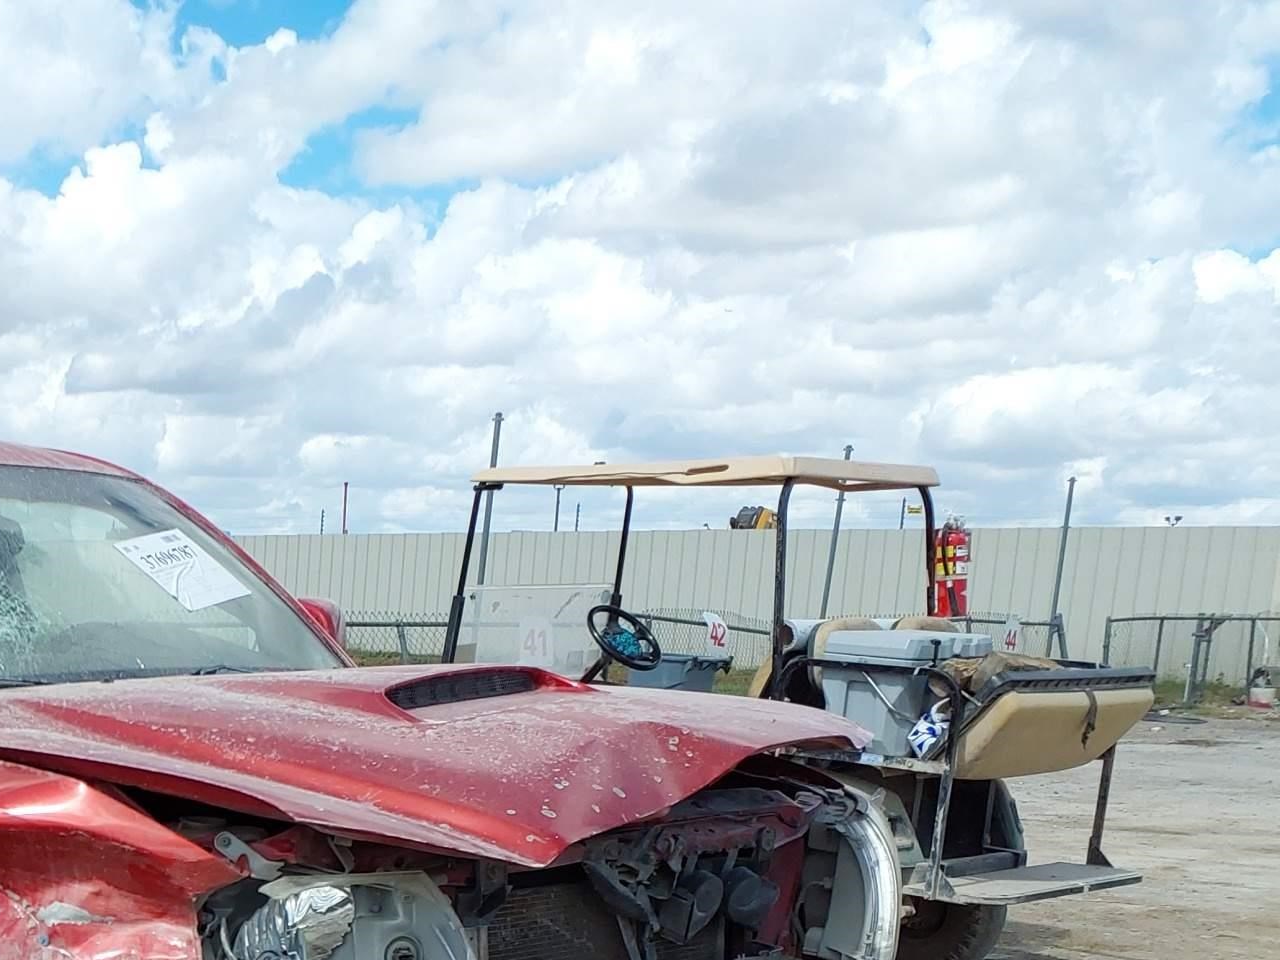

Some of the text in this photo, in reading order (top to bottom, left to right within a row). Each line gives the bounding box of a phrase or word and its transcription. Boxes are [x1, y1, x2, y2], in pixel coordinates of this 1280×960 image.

[140, 545, 198, 569] 37696787
[523, 628, 548, 657] 41
[709, 621, 726, 648] 42
[1004, 628, 1018, 651] 44
